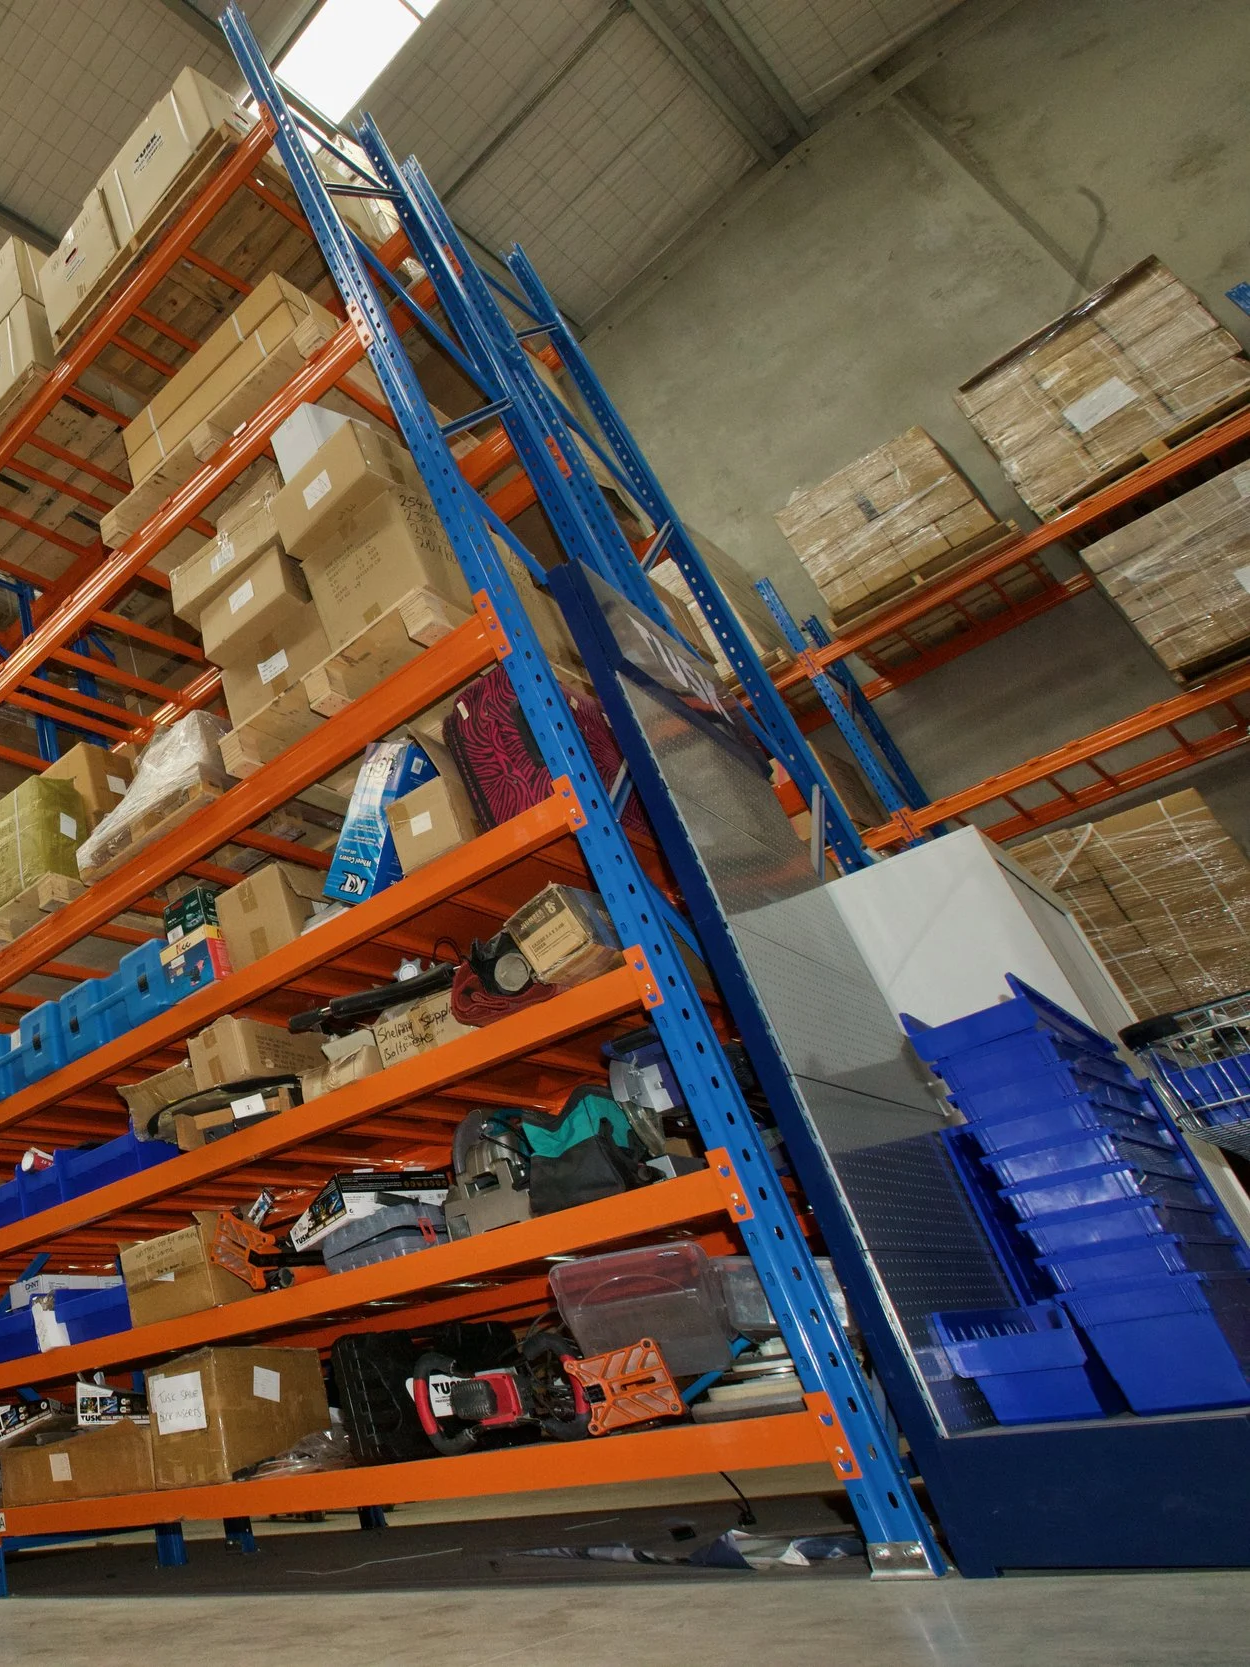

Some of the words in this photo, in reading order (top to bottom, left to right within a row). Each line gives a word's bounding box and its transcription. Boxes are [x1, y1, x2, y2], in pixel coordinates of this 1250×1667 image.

[626, 613, 735, 725] TUSK
[295, 1232, 310, 1244] TUSK
[431, 1381, 461, 1395] TU
[80, 1414, 101, 1422] TUSK
[0, 1516, 5, 1529] A
